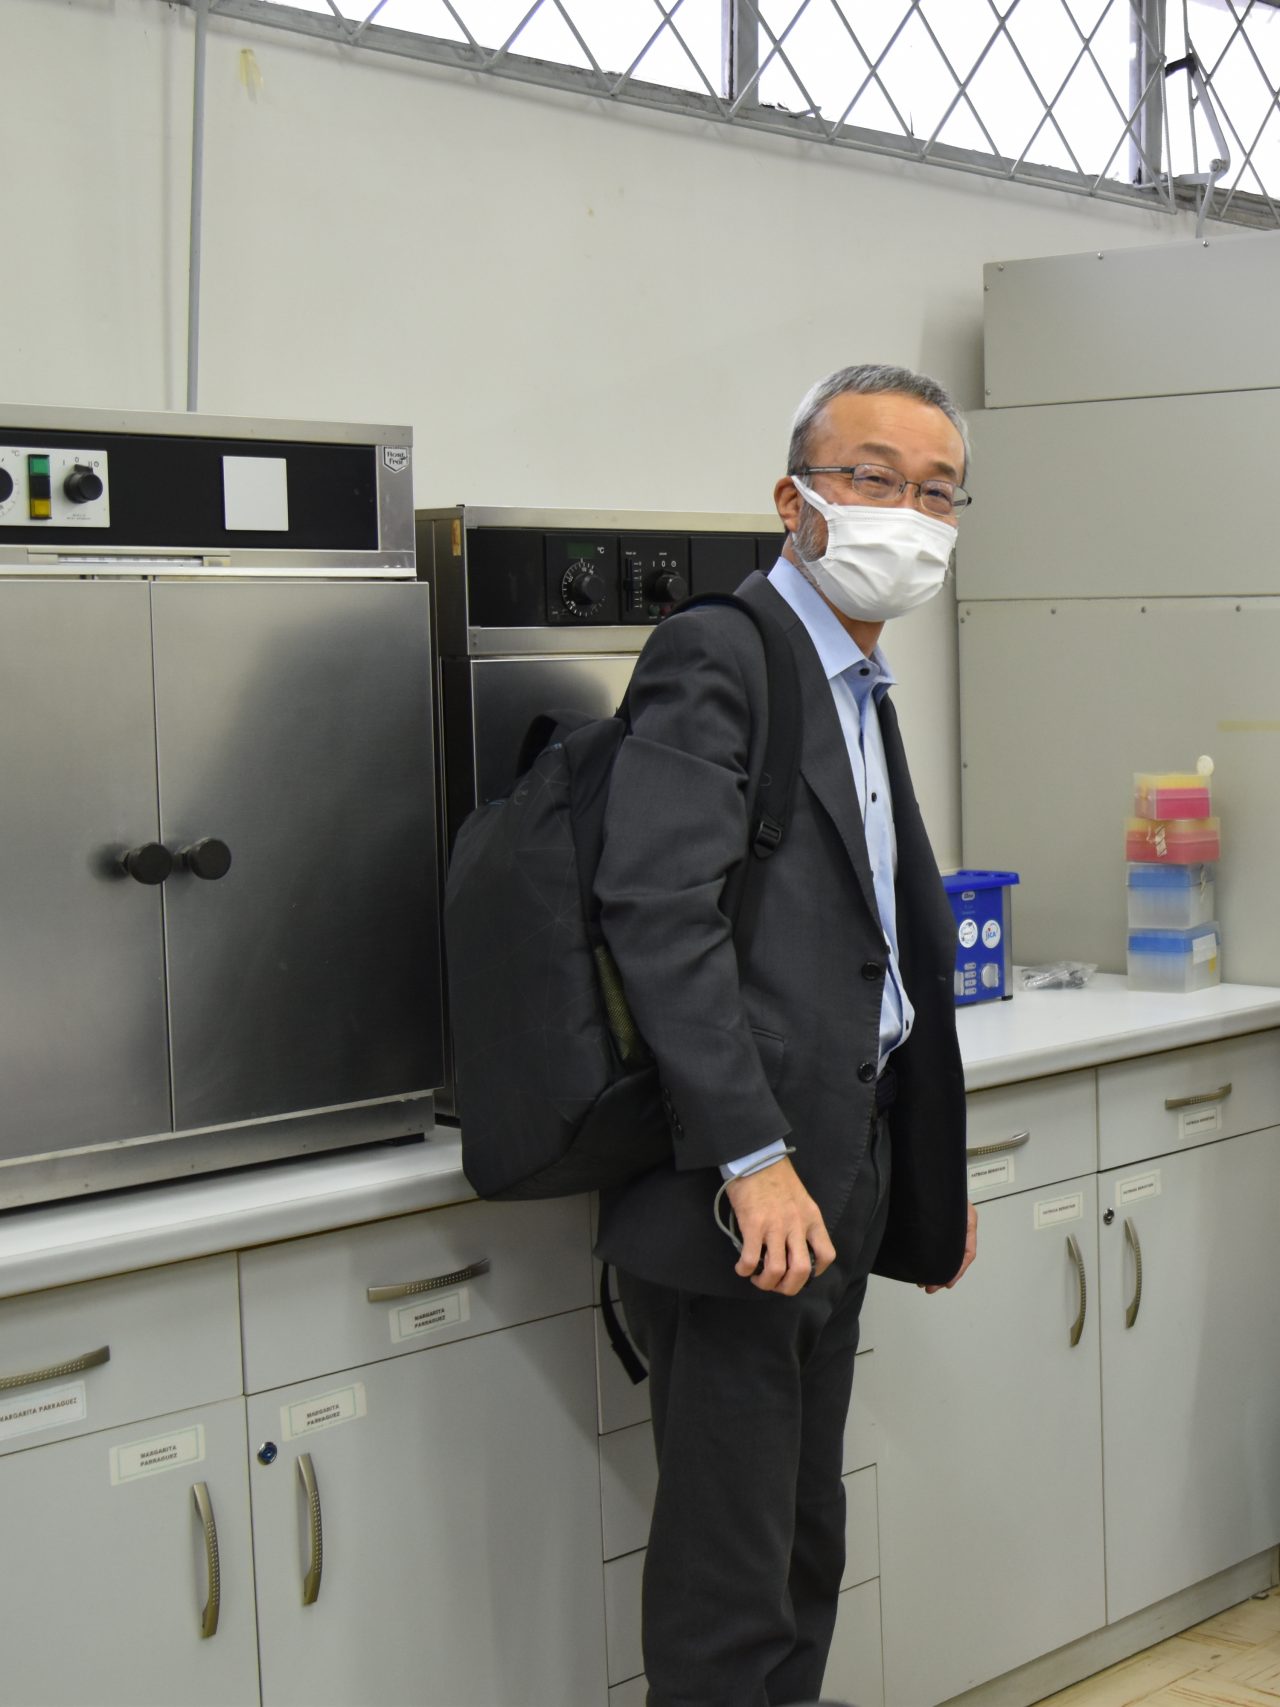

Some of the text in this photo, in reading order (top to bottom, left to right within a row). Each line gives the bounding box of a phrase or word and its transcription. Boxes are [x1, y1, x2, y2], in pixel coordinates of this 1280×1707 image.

[39, 1397, 77, 1413] PARRAGUEZ
[306, 1404, 340, 1418] MARGARITA
[307, 1411, 341, 1426] PARRAGUEZ
[140, 1445, 177, 1459] MARGARITA
[140, 1453, 178, 1467] PARRAGUEZ
